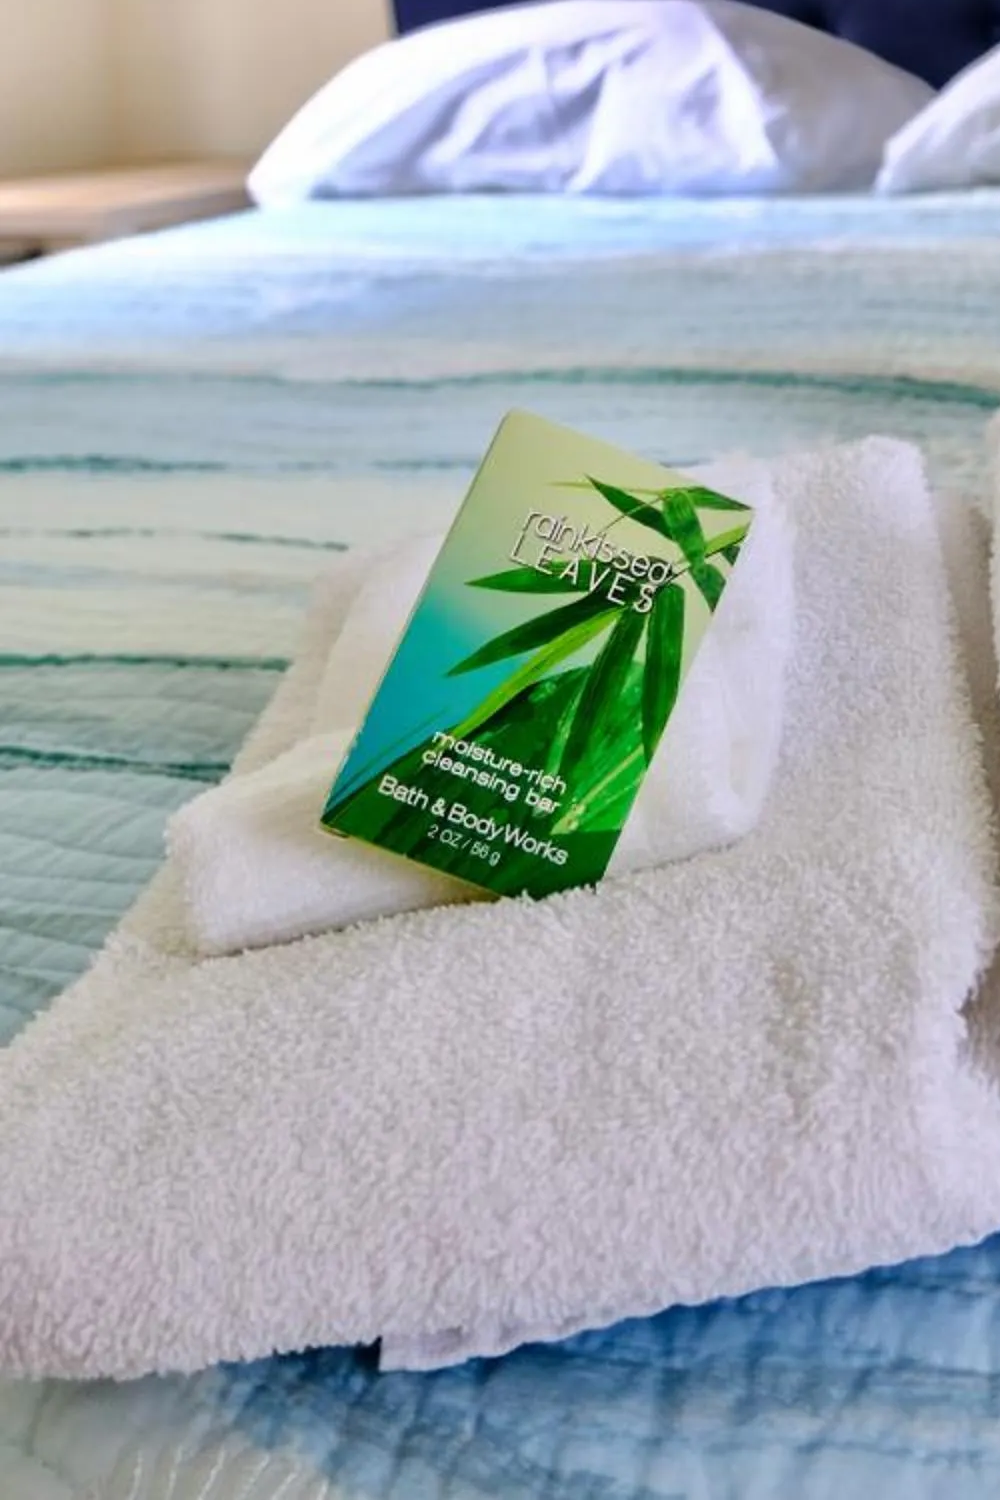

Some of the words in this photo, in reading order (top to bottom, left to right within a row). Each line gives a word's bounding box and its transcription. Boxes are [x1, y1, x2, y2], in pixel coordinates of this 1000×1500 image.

[511, 529, 657, 613] LEAVES
[378, 773, 429, 810] Bath
[430, 798, 447, 817] &
[421, 750, 520, 801] cleansing
[525, 787, 561, 814] bar
[432, 731, 567, 795] moisture-rich
[427, 824, 438, 839] 2
[439, 828, 463, 848] OZ
[489, 851, 501, 867] g
